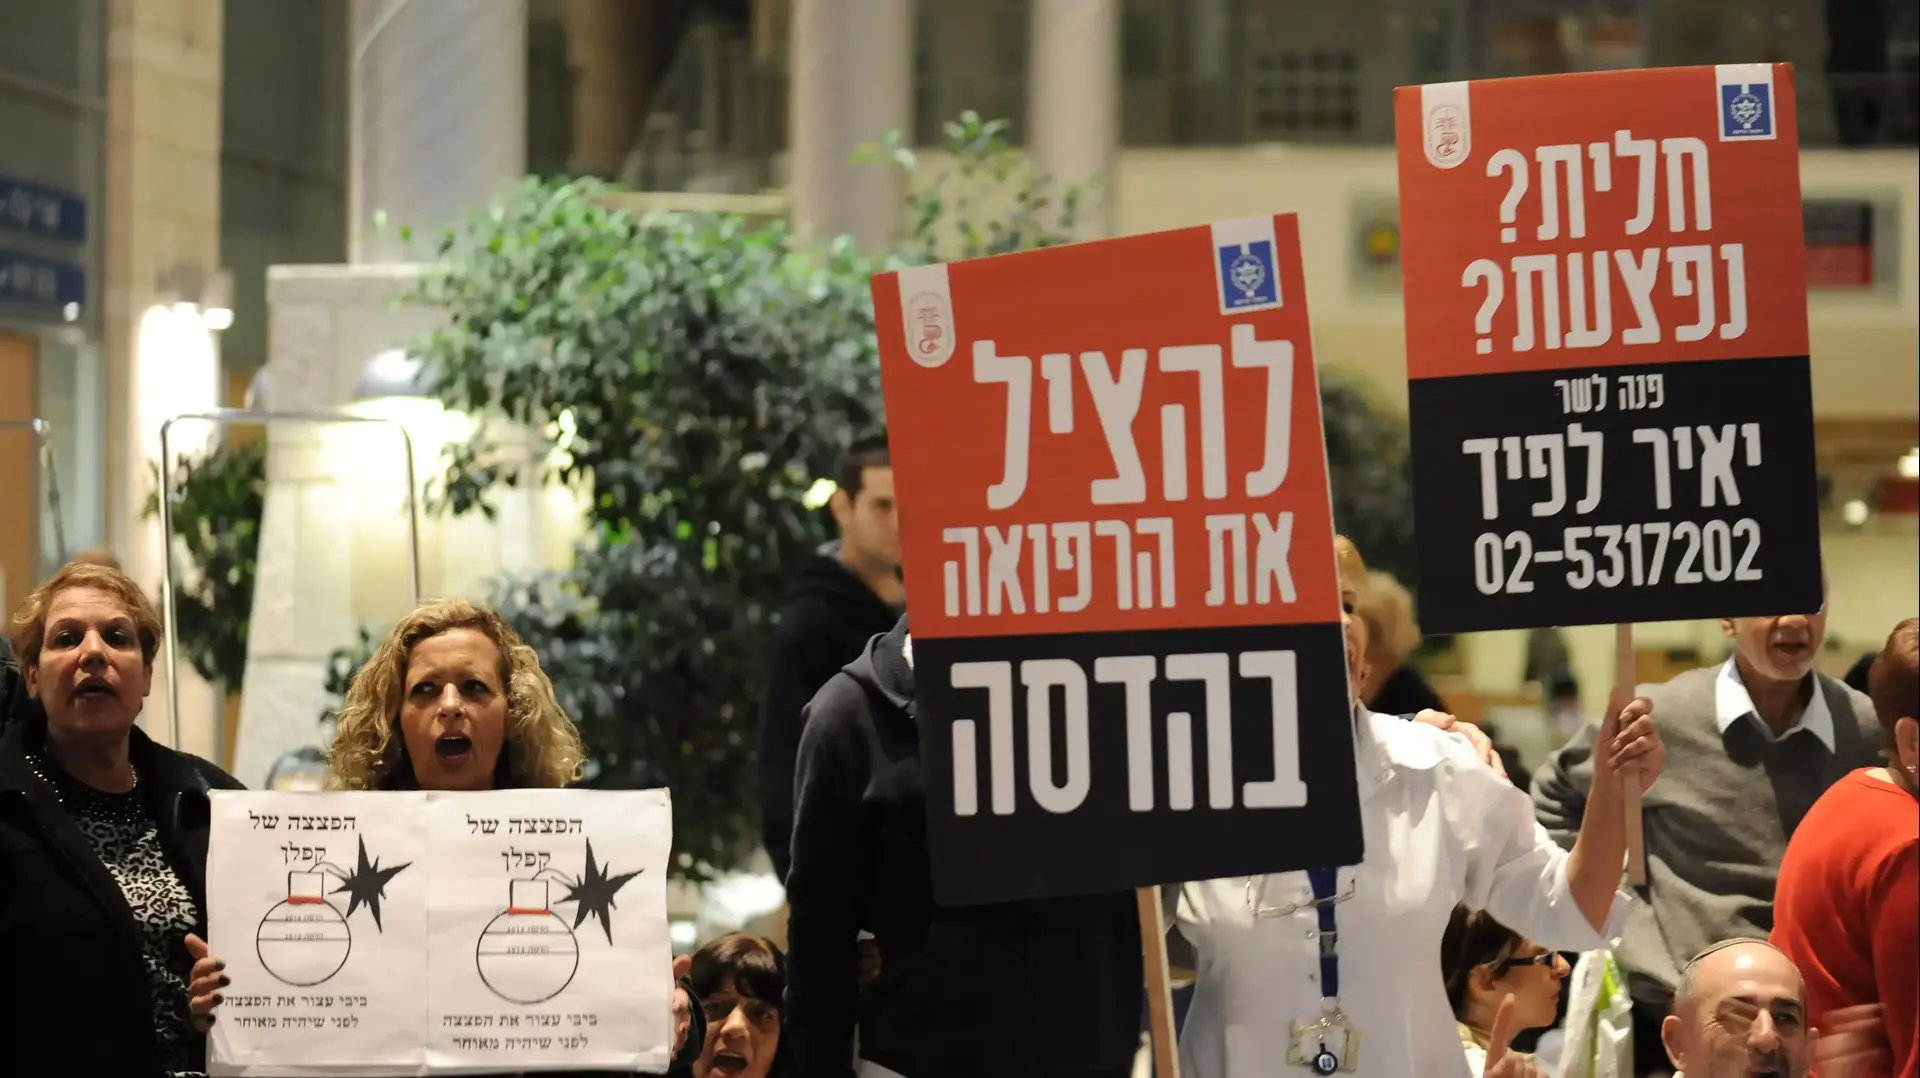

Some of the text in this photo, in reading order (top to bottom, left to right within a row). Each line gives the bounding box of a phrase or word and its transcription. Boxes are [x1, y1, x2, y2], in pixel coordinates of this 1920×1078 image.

[1486, 129, 1713, 244] חלית?
[1461, 242, 1749, 355] נפצעת?
[1553, 373, 1665, 414] פנה לשר
[972, 323, 1295, 510] להציל
[1462, 422, 1763, 521] יאיר לפיד
[942, 511, 1297, 617] את הרפואה
[1473, 517, 1764, 596] 02-5317202
[950, 649, 1308, 816] בהדסה
[248, 809, 357, 831] הפצצה של
[466, 813, 583, 835] הפצצה של
[280, 841, 327, 865] קפלן
[501, 846, 551, 872] קפלן
[224, 995, 368, 1007] ביבי עצור את הפצצה
[234, 1014, 359, 1029] לפני שיהיה מאוחר
[442, 1013, 598, 1027] ביבי עצור את הפצצה
[452, 1033, 589, 1050] לפני שיהיה מאוחר
